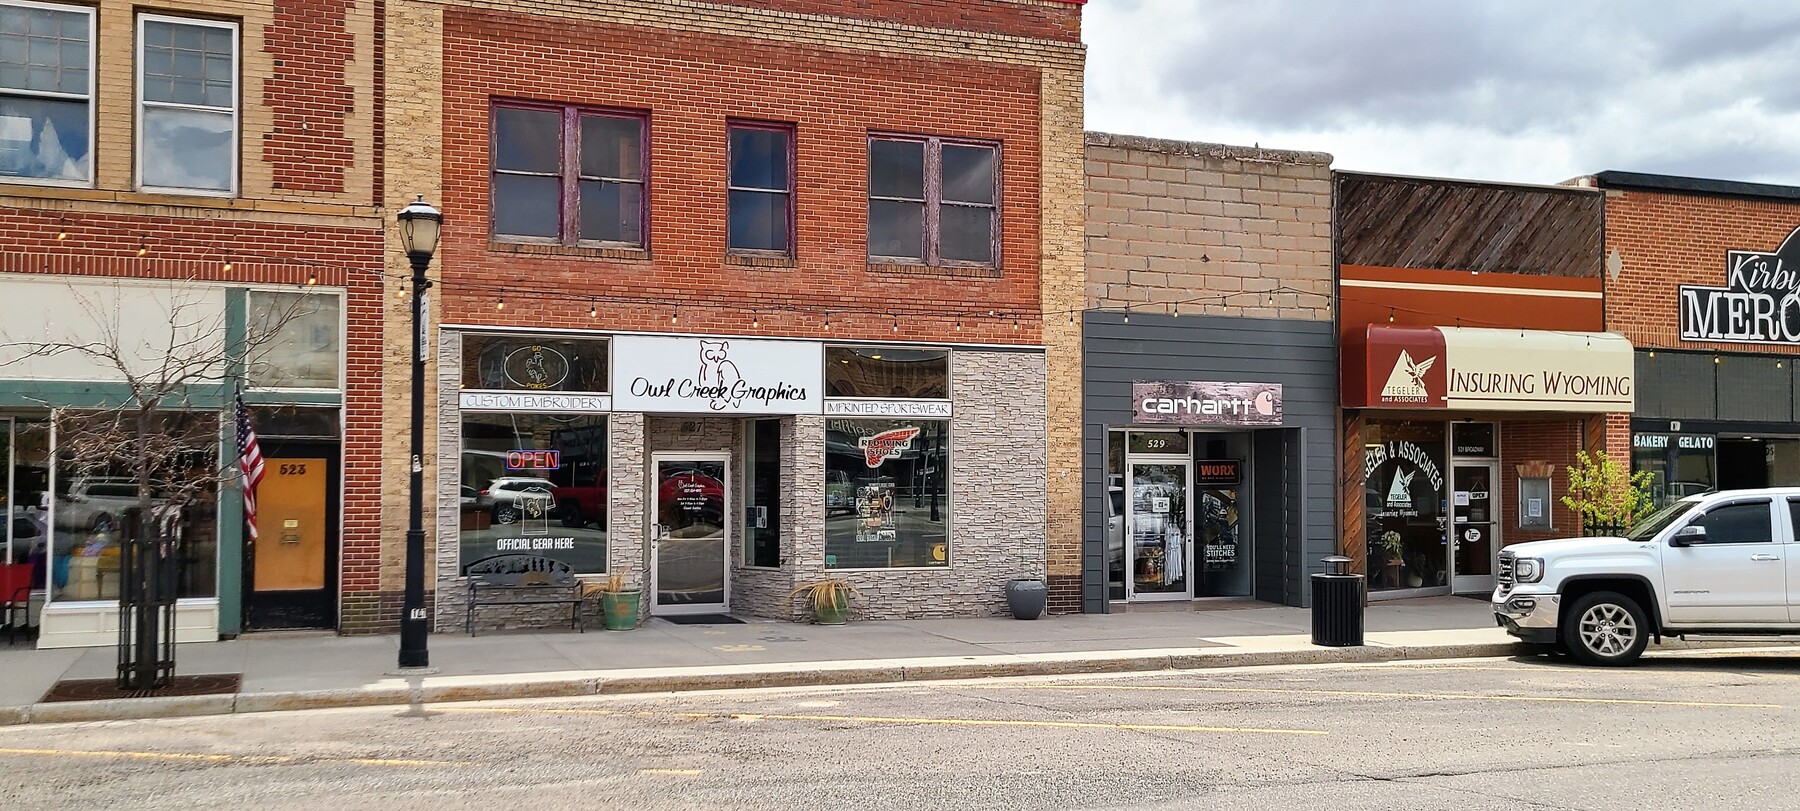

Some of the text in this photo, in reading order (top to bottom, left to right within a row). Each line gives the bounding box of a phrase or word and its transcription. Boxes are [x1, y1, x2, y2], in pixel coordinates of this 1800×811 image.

[1450, 368, 1630, 396] INSURING WYOMING
[630, 377, 806, 406] Owl Creek Graphics
[1387, 386, 1420, 395] TEGELER
[466, 395, 604, 408] CUSTOM EMBROIDERY
[1142, 396, 1252, 415] carhartt
[828, 403, 948, 414] IMPRINTED SPORTSWEAR
[1148, 440, 1165, 448] 529
[1634, 435, 1713, 448] BAKERY GELATO
[508, 452, 558, 468] OPEN
[1390, 440, 1396, 459] &
[1398, 440, 1442, 491] ASSOCIATES
[280, 464, 306, 475] 523
[1200, 465, 1235, 476] WORX
[496, 538, 574, 550] OFFICIAL GEAR HERE
